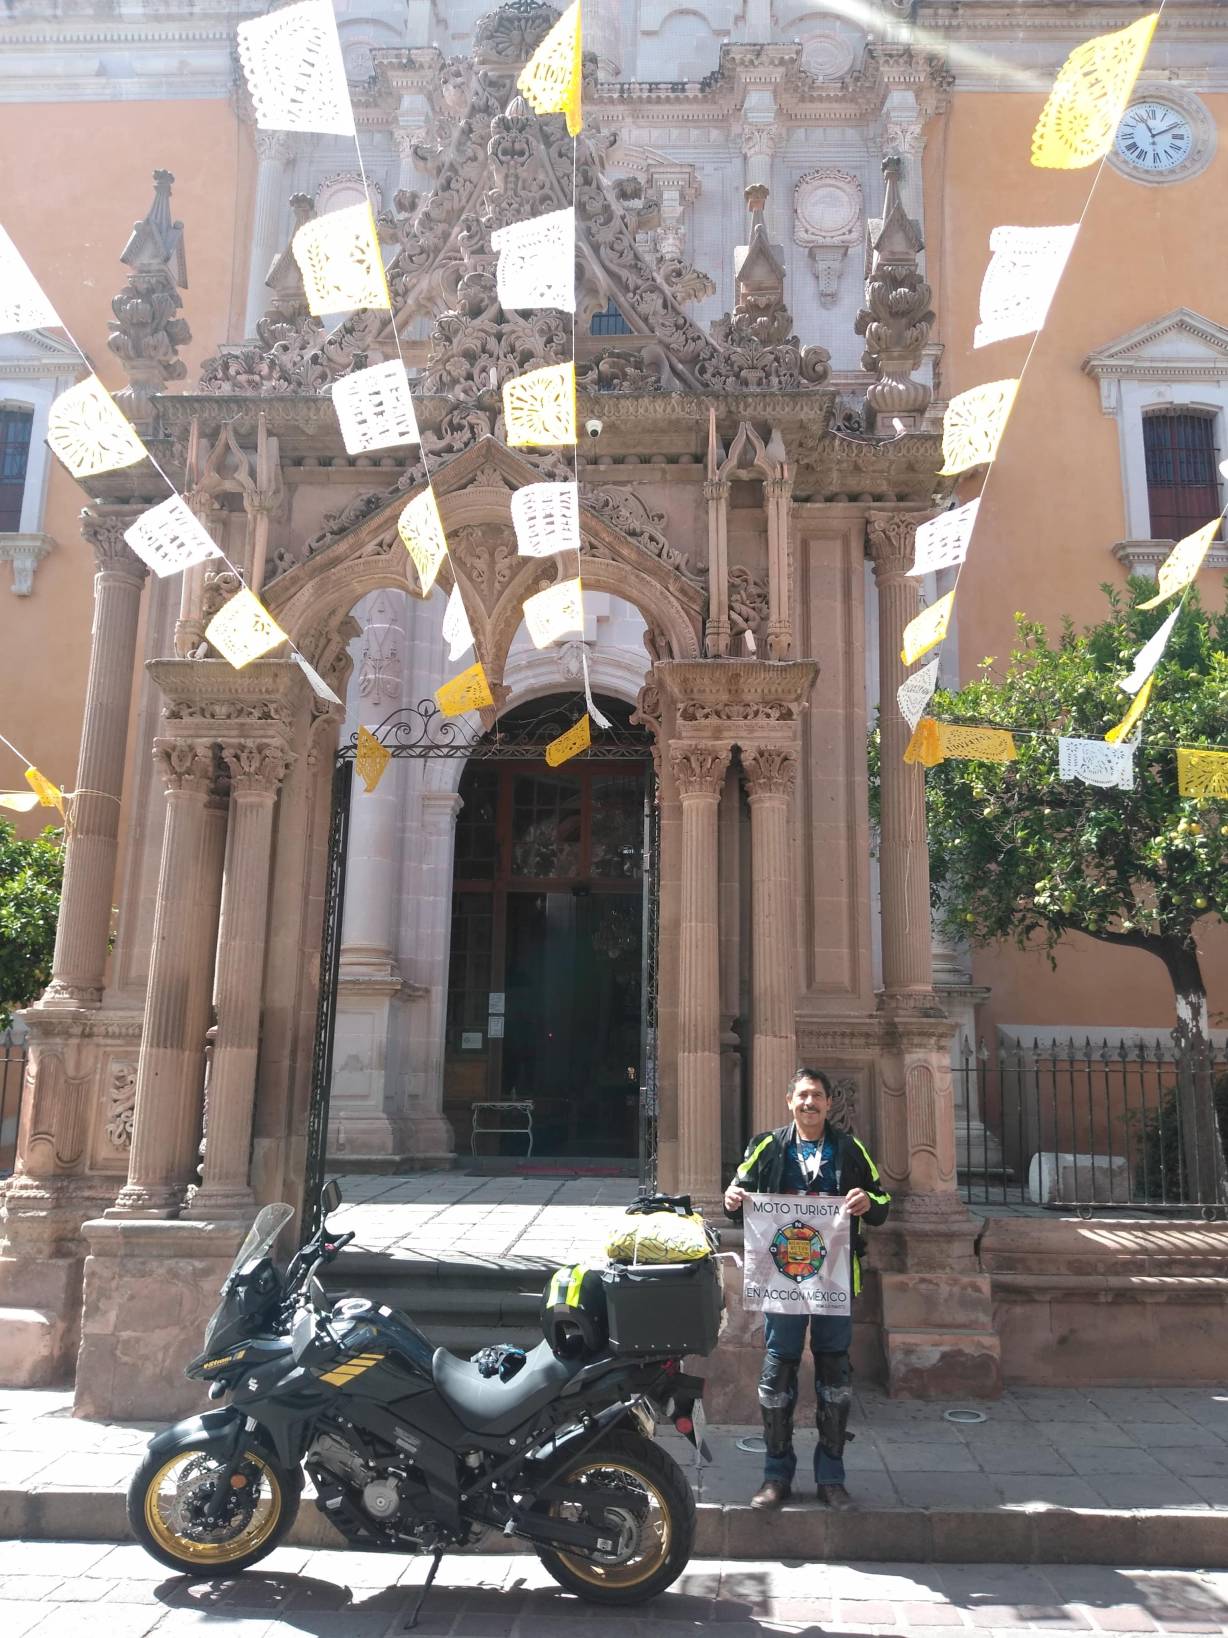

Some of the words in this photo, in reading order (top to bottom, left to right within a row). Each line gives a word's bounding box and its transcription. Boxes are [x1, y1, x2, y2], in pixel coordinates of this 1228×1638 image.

[753, 1202, 791, 1214] MOTO
[793, 1203, 840, 1216] TURISTA
[746, 1287, 761, 1298] EN
[763, 1288, 805, 1301] ACCIÓN
[806, 1288, 847, 1302] MÉXICO
